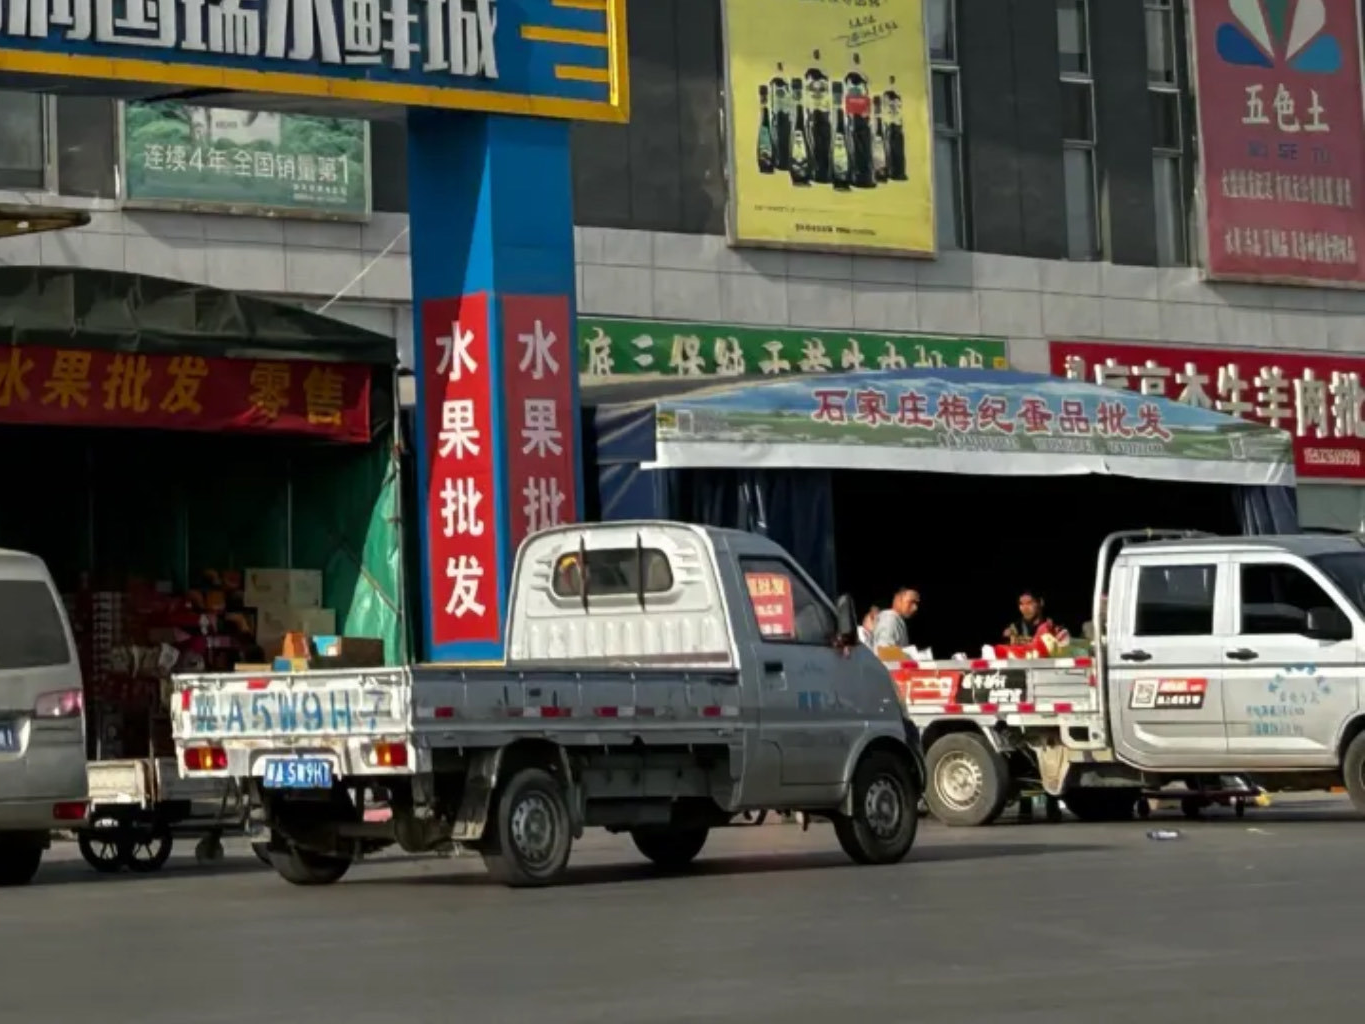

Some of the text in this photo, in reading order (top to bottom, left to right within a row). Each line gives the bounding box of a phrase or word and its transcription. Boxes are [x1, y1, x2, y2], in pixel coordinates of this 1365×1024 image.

[1242, 82, 1330, 132] 五色土
[249, 362, 345, 426] 零售
[518, 320, 566, 532] 水果批
[436, 320, 486, 619] 水果批发
